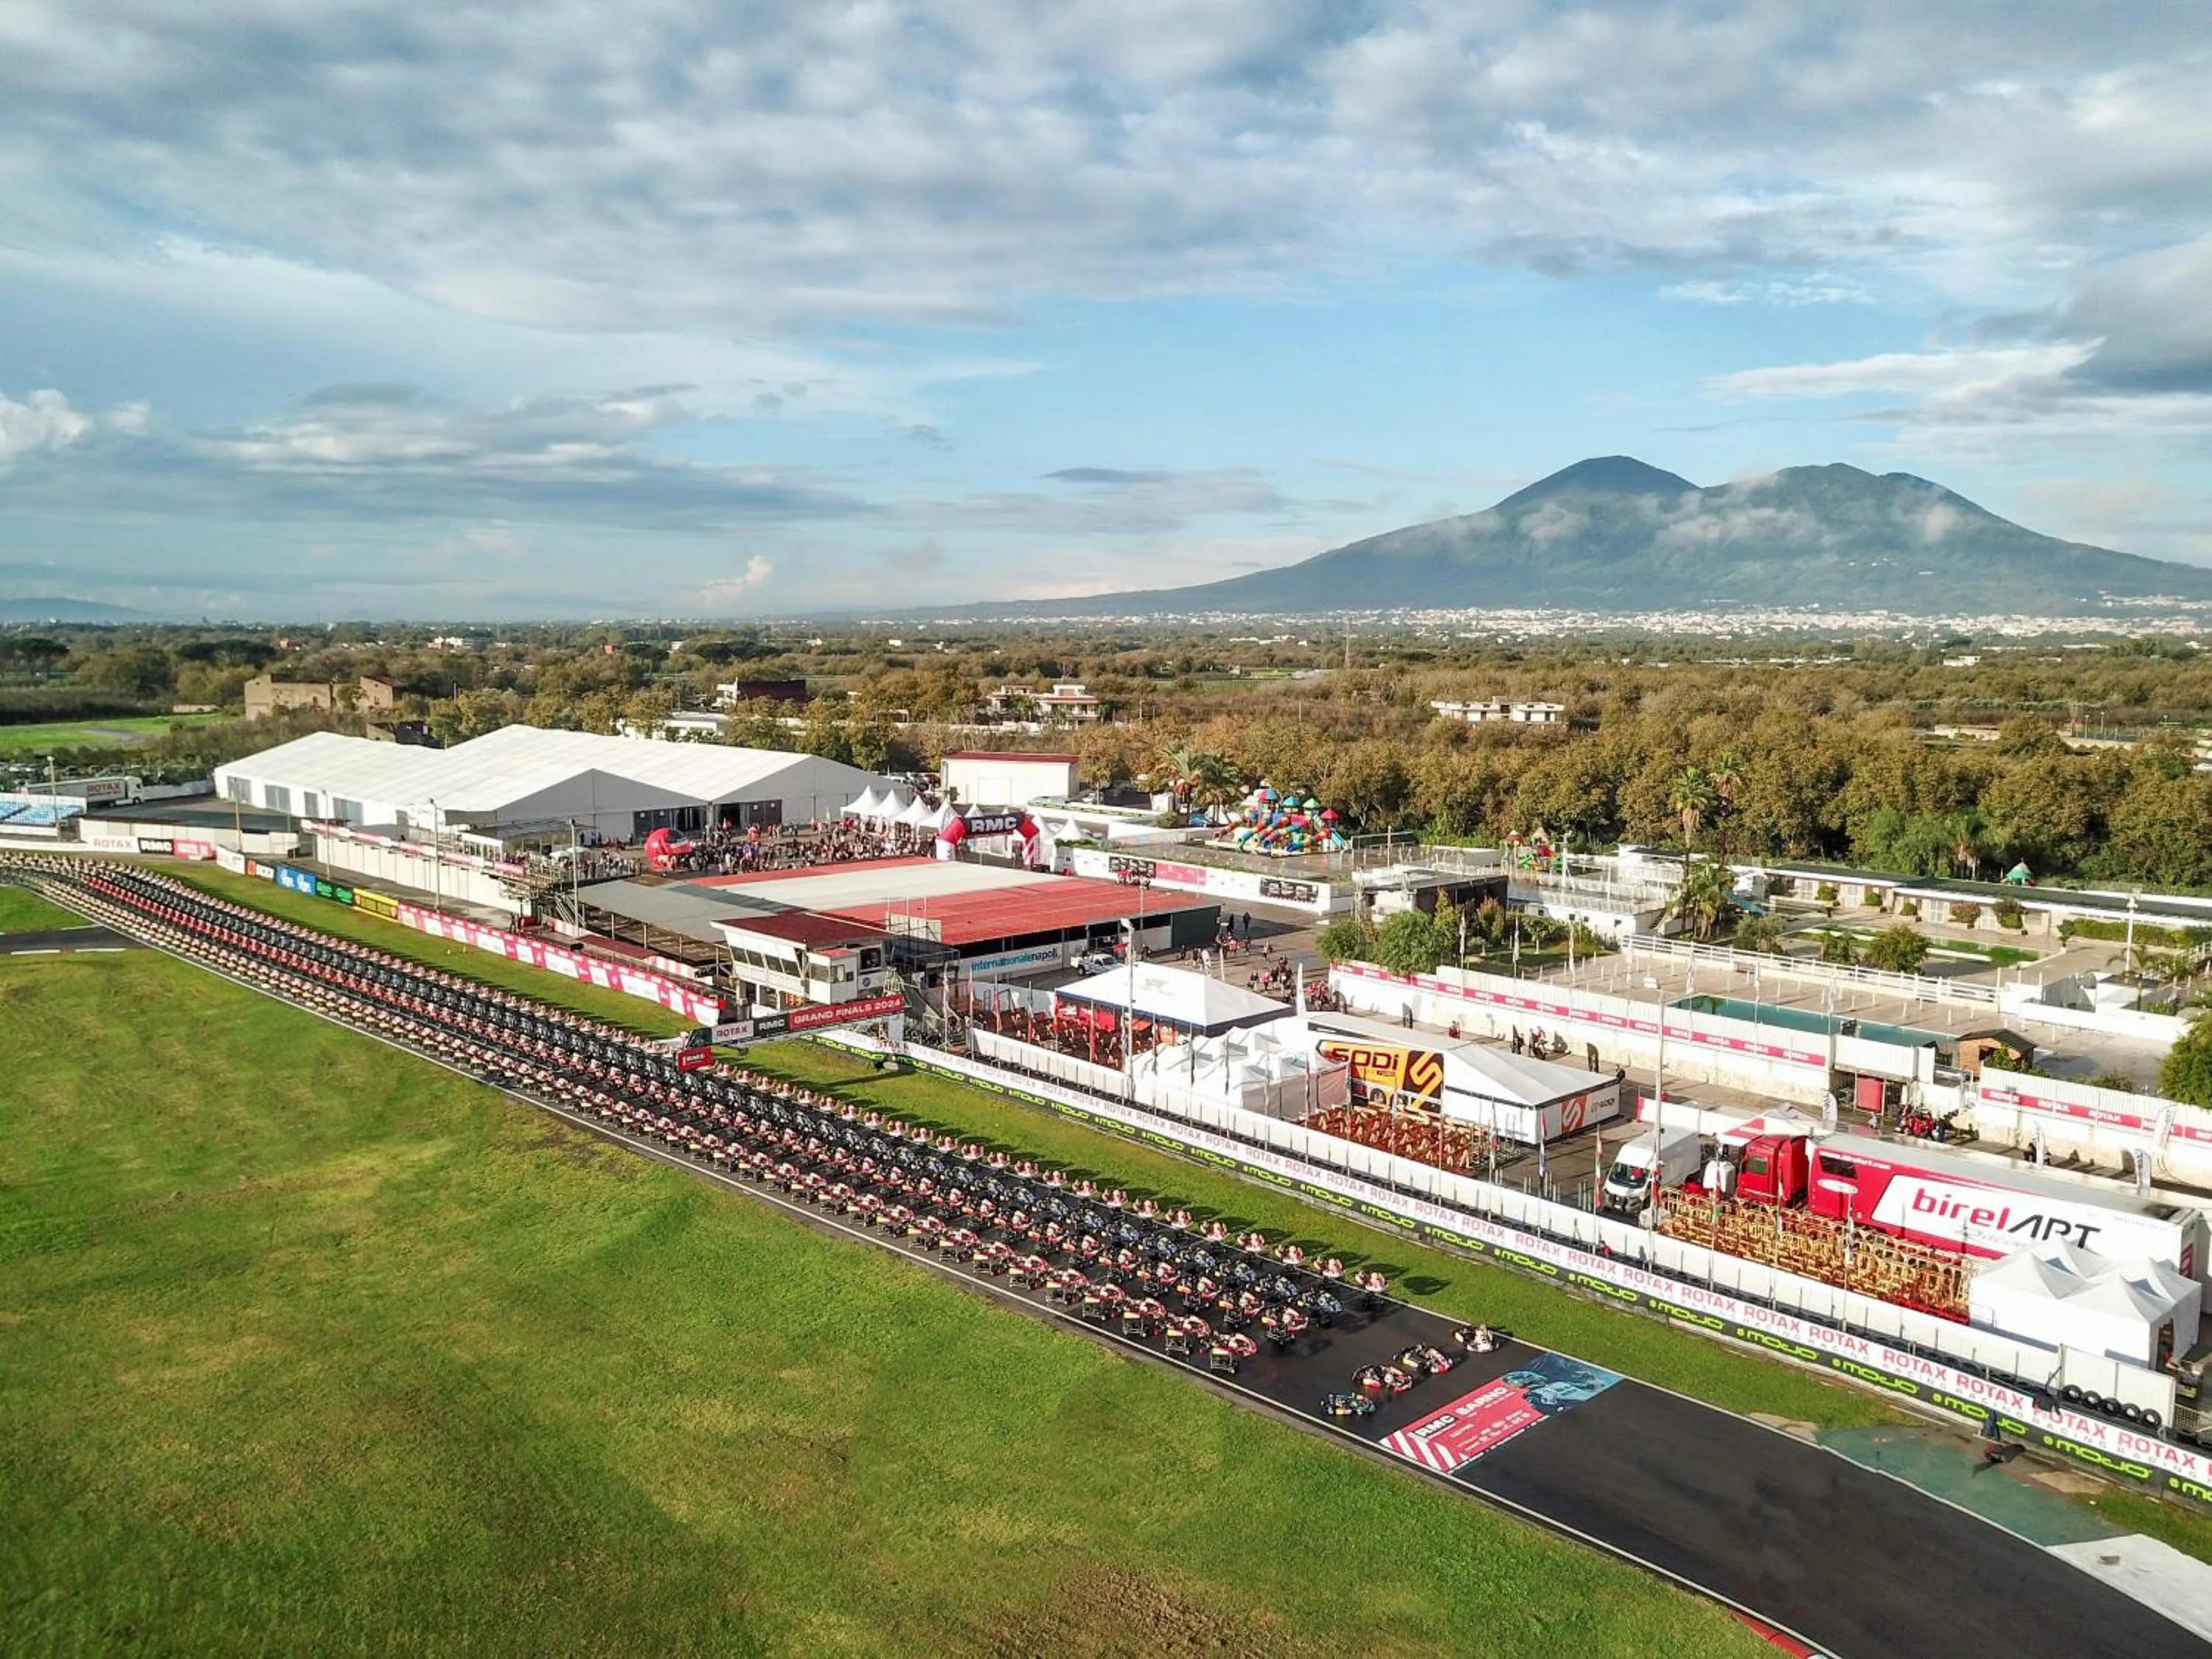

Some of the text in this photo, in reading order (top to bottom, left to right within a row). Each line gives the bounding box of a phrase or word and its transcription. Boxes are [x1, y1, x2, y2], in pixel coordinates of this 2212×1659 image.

[87, 782, 121, 793] ROTAX
[93, 838, 133, 848] ROTAX
[971, 816, 1017, 832] RMC
[716, 998, 901, 1037] ROTAX RMC GRAND FINALS 2024
[1170, 1124, 1201, 1140] ROTAX
[1206, 1134, 1238, 1152] ROTAX
[1245, 1146, 1280, 1166] ROTAX
[1285, 1160, 1321, 1178] ROTAX
[1326, 1172, 1364, 1193] ROTAX
[1370, 1188, 1409, 1208] ROTAX
[1415, 1202, 1457, 1223] ROTAX
[1462, 1217, 1506, 1239] ROTAX
[1515, 1233, 1561, 1257] ROTAX
[1567, 1251, 1617, 1274] ROTAX
[1623, 1267, 1673, 1293] ROTAX
[1682, 1286, 1736, 1312] ROTAX
[1744, 1305, 1800, 1333] ROTAX
[1809, 1326, 1869, 1355] ROTAX
[1882, 1349, 1947, 1381] ROTAX
[1956, 1374, 2024, 1410] ROTAX
[2118, 1431, 2197, 1470] ROTAX
[1413, 1414, 1455, 1437] RMC
[1455, 1386, 1509, 1416] SARNO
[1955, 1388, 2025, 1419] RACING
[2118, 1447, 2197, 1479] RACING
